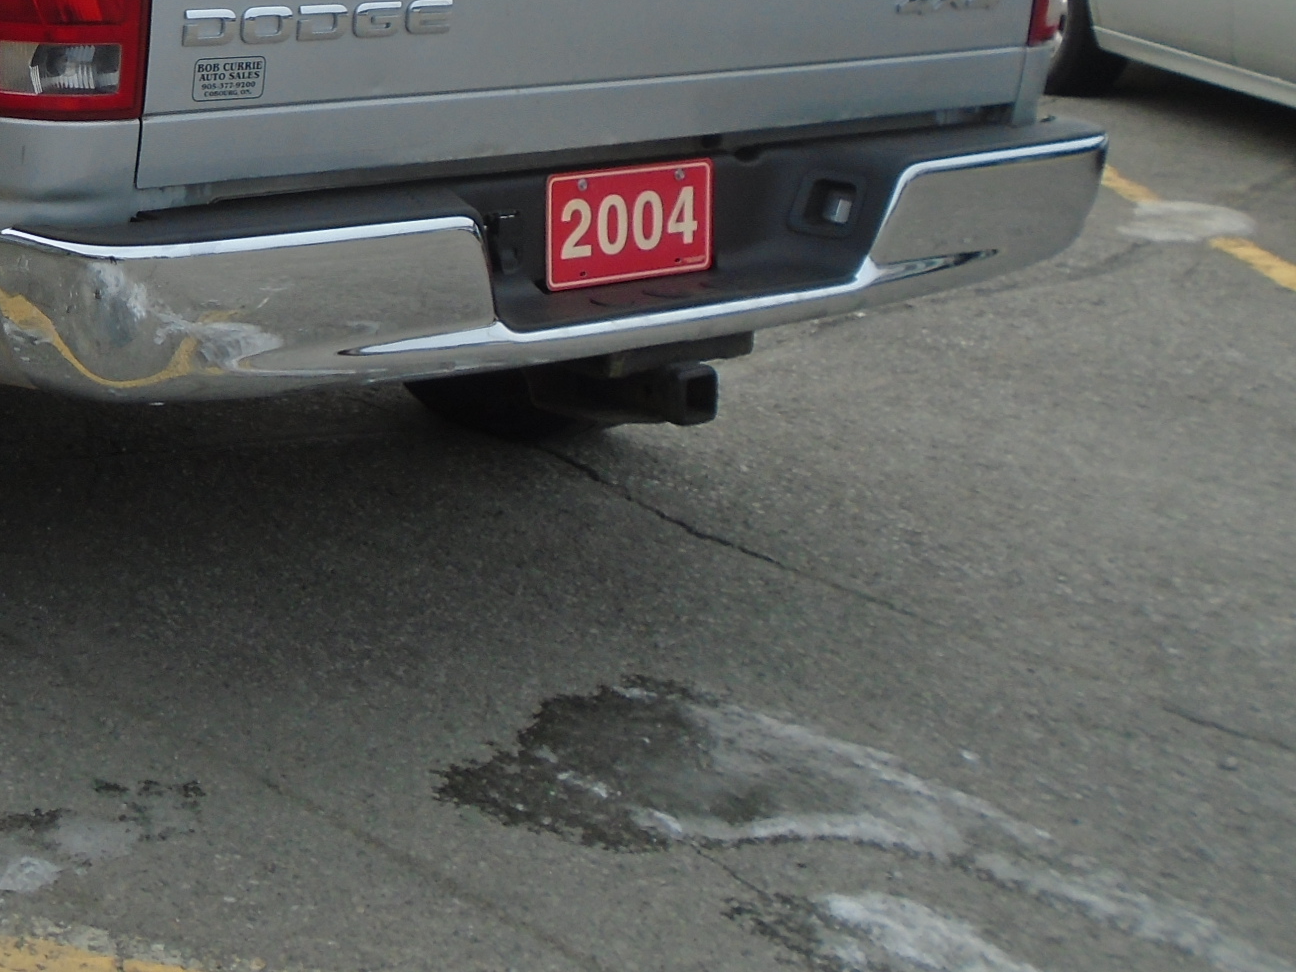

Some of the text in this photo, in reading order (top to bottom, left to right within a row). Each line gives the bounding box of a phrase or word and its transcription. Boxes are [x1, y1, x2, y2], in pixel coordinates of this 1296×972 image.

[197, 61, 263, 73] BOB CURRIE
[198, 71, 260, 82] AUTO SALES
[561, 185, 698, 260] 2004
